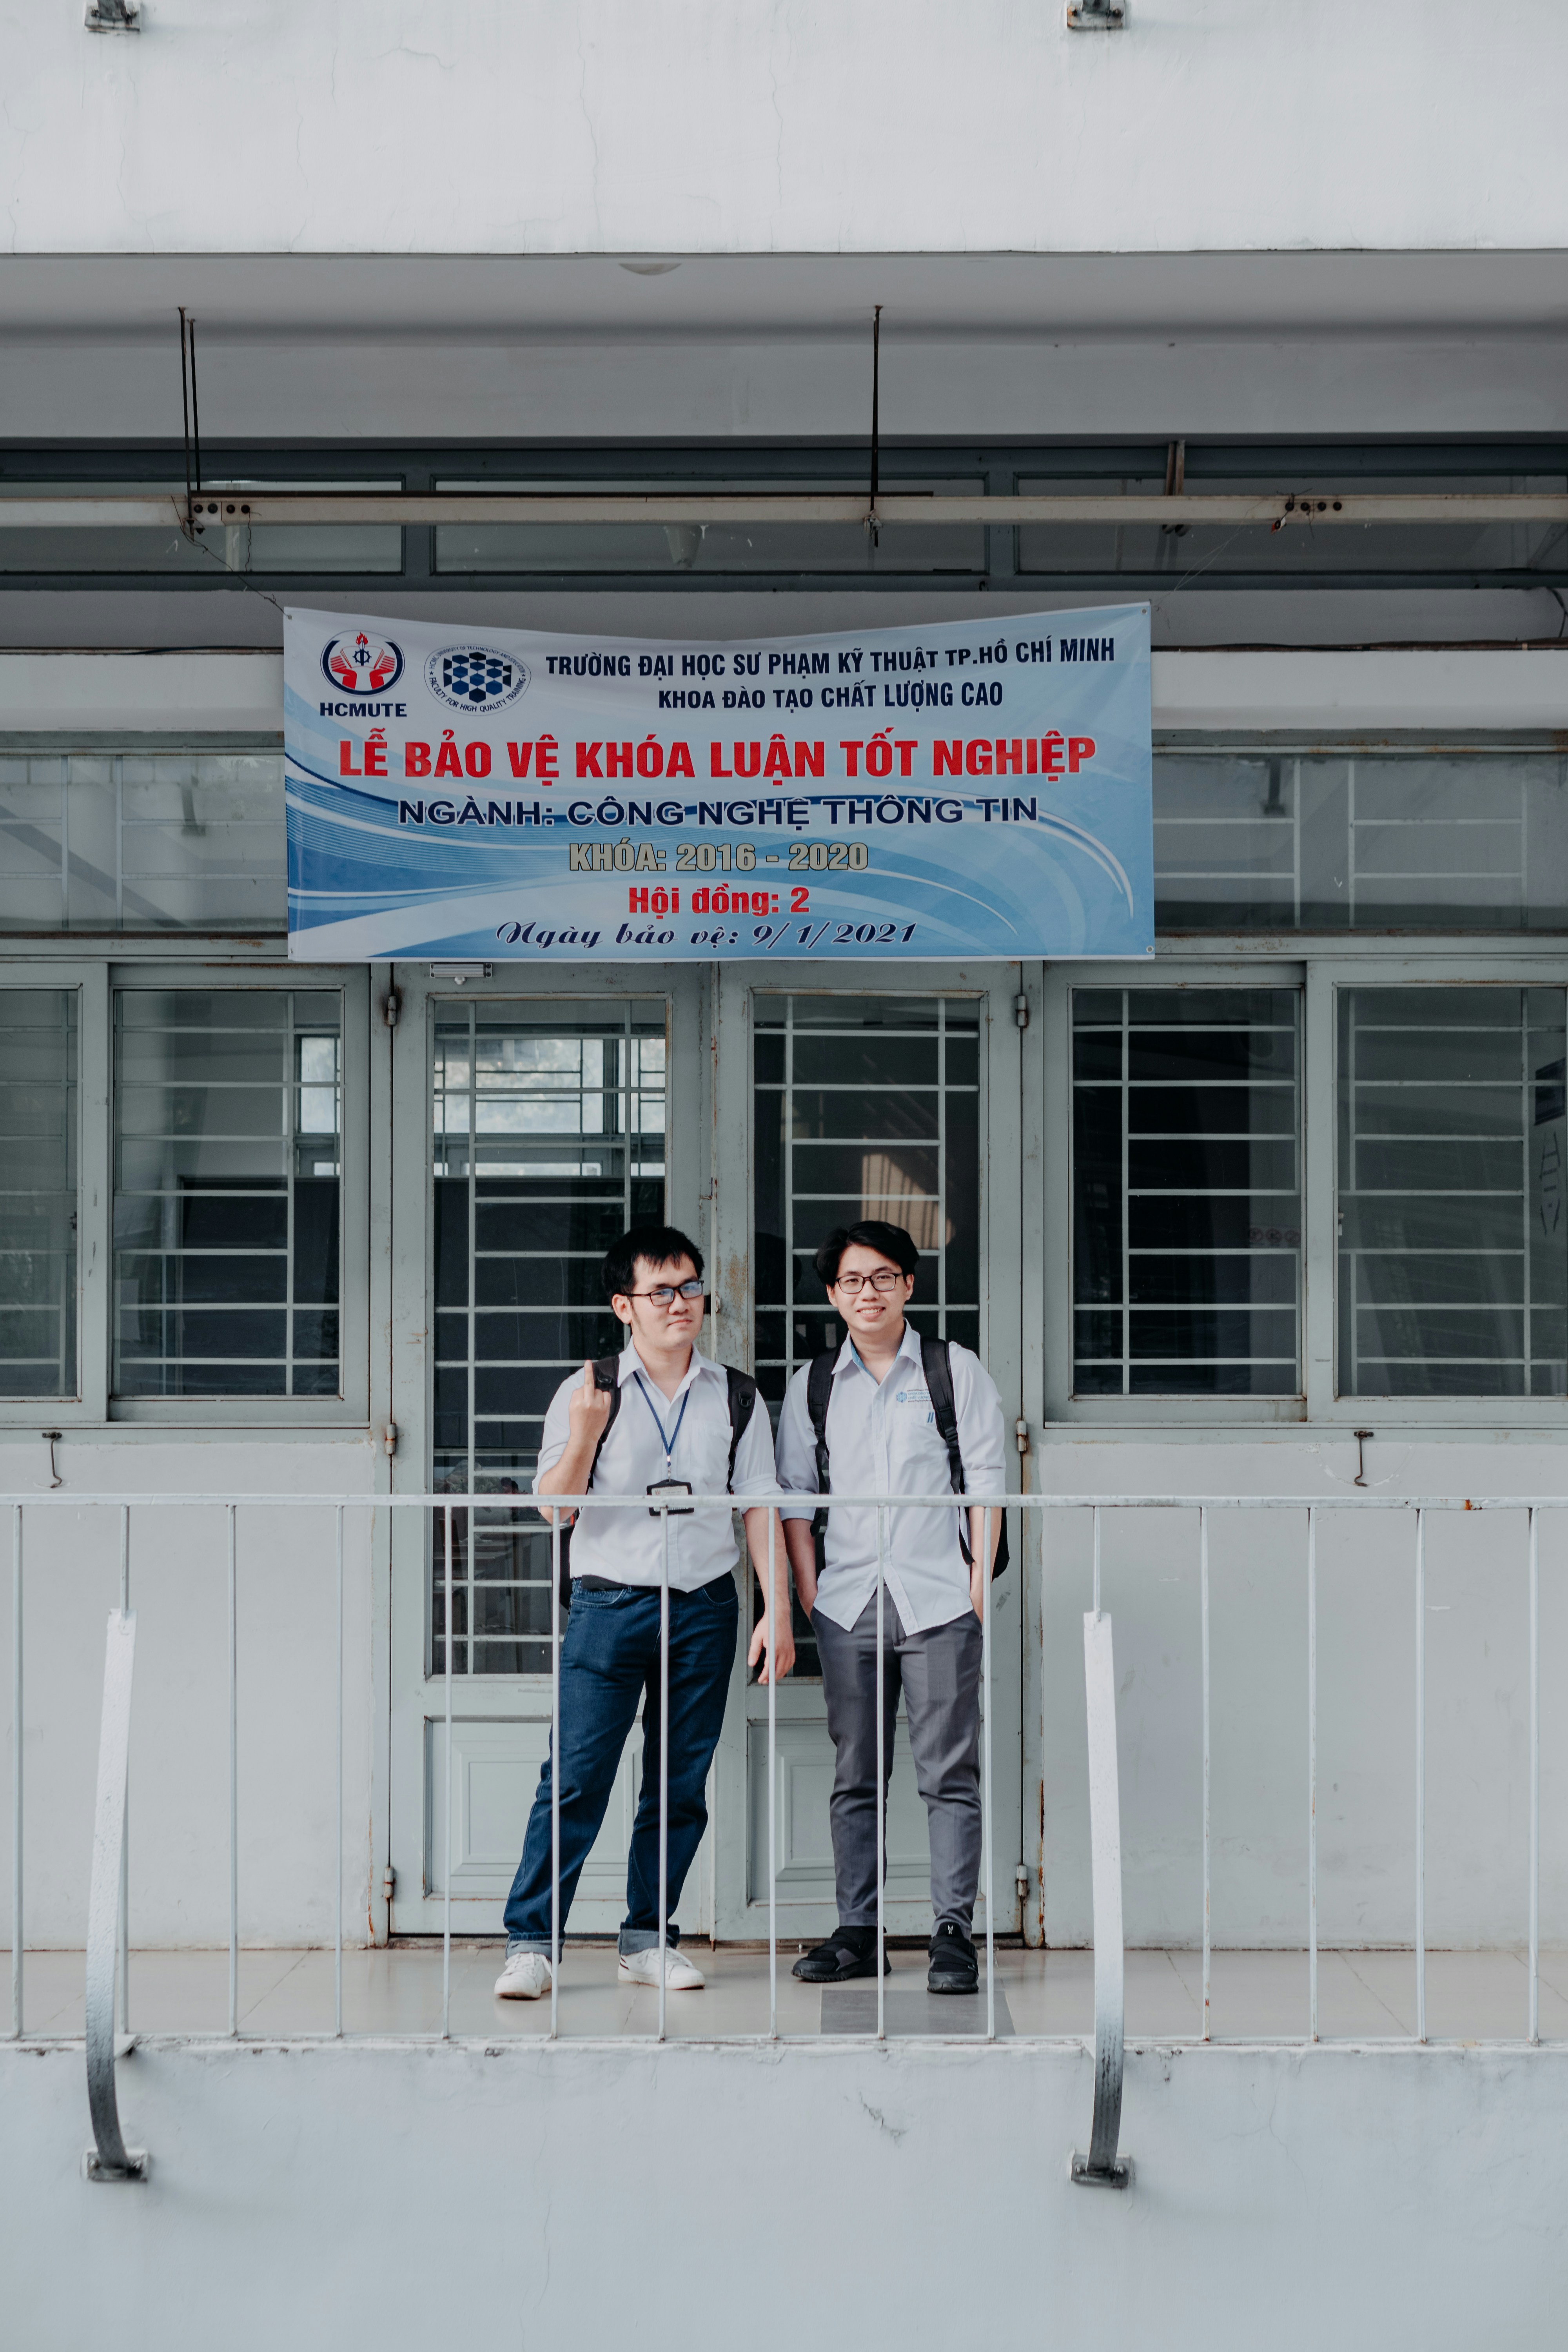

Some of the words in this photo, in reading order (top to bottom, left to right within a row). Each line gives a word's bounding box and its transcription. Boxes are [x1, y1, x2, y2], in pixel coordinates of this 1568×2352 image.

[466, 646, 500, 655] TECHNOLOGY
[546, 652, 630, 676] TRƯỜNG
[638, 655, 673, 680] ĐẠI
[682, 655, 725, 680] HỌC
[733, 652, 761, 675] SƯ
[769, 653, 829, 679] PHẠM
[838, 648, 863, 673] KỸ
[870, 647, 938, 672] THUẬT
[945, 639, 1007, 666] TP.HỒ
[1016, 635, 1051, 662] CHÍ
[1060, 638, 1114, 661] MINH
[320, 703, 407, 717] HCMUTE
[429, 677, 447, 699] FACULTY
[445, 697, 459, 708] FOR
[459, 704, 477, 712] HIGH
[479, 698, 507, 712] QUALITY
[505, 677, 526, 701] TRAINING
[659, 691, 715, 708] KHOA
[722, 686, 765, 708] ĐÀO
[773, 689, 813, 713] TẠO
[822, 680, 876, 707] CHẤT
[885, 680, 953, 711] LƯỢNG
[962, 682, 1002, 706] CAO
[341, 728, 387, 776] LỄ
[406, 730, 490, 777] BẢO
[507, 735, 558, 786] VỆ
[576, 735, 695, 777] KHÓA
[711, 734, 824, 785] LUẬN
[840, 728, 918, 777] TỐT
[934, 731, 1095, 781] NGHIỆP
[399, 796, 554, 824] NGÀNH:
[567, 797, 684, 825] CÔNG
[699, 798, 810, 830] NGHỆ
[823, 795, 962, 824] THÔNG
[981, 798, 1036, 821] TIN
[570, 837, 666, 871] KHÓA:
[676, 844, 755, 871] 2016
[789, 844, 868, 870] 2020
[630, 887, 679, 919] Hội
[692, 884, 778, 916] đồng:
[791, 887, 808, 912] 2
[497, 922, 601, 949] Ngày
[615, 923, 677, 944] bảo
[691, 927, 738, 948] vệ:
